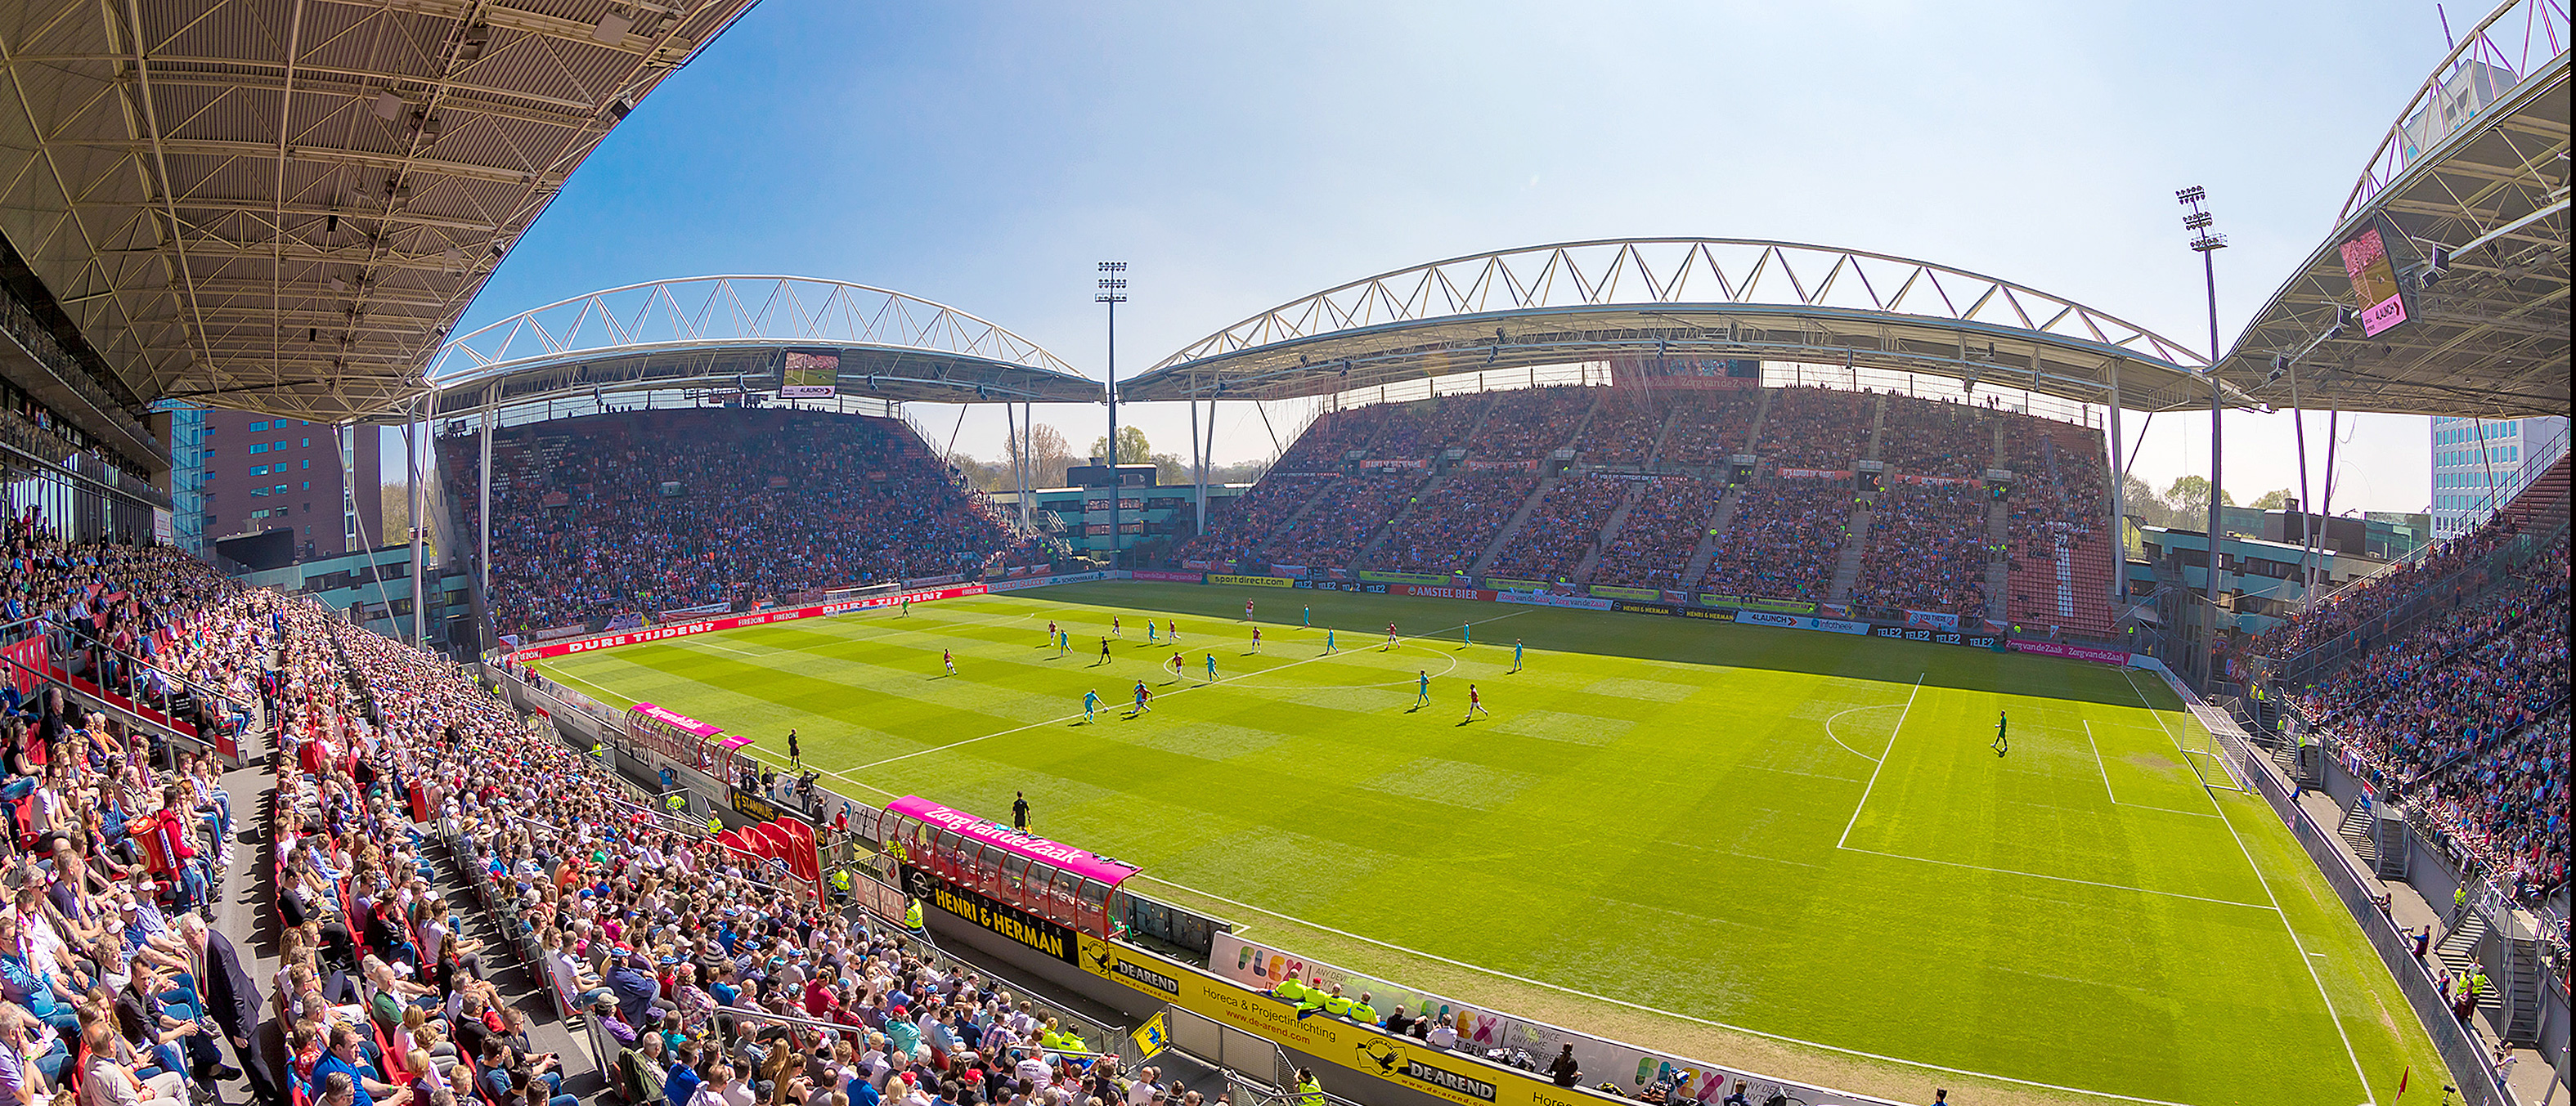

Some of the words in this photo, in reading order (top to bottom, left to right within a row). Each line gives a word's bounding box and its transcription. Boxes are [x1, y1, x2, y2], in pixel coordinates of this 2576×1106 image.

[1295, 580, 1313, 589] TELE2
[1318, 581, 1336, 590] TELE2
[1342, 583, 1361, 592] TEL2
[1367, 584, 1386, 593] TELE2
[1416, 586, 1454, 598] AMSTEL
[1456, 589, 1478, 600] BIER
[1752, 614, 1787, 624] 4LAUNCH
[568, 635, 626, 653] DURE
[633, 623, 715, 643] TIJDEN?
[1877, 627, 1902, 638] TELE2
[1905, 630, 1931, 642] TELE2
[1936, 634, 1961, 645] TELE2
[1969, 637, 1995, 648] TELE2
[741, 795, 774, 821] STAMHUIS
[935, 888, 977, 922] HENRI
[981, 907, 992, 927] &
[993, 911, 1063, 959] HERMAN
[1315, 968, 1330, 977] ANY
[1331, 971, 1356, 985] DEVICE
[1203, 986, 1238, 1006] Horeca
[1241, 1000, 1249, 1010] &
[1252, 1003, 1336, 1042] Projectinrichting
[1226, 1010, 1310, 1045] www.de-arend.com
[1513, 1023, 1530, 1035] ANY
[1531, 1027, 1561, 1043] DEVICE
[1510, 1034, 1547, 1050] ANYTIME
[1401, 1079, 1490, 1106] www.de-arend.co
